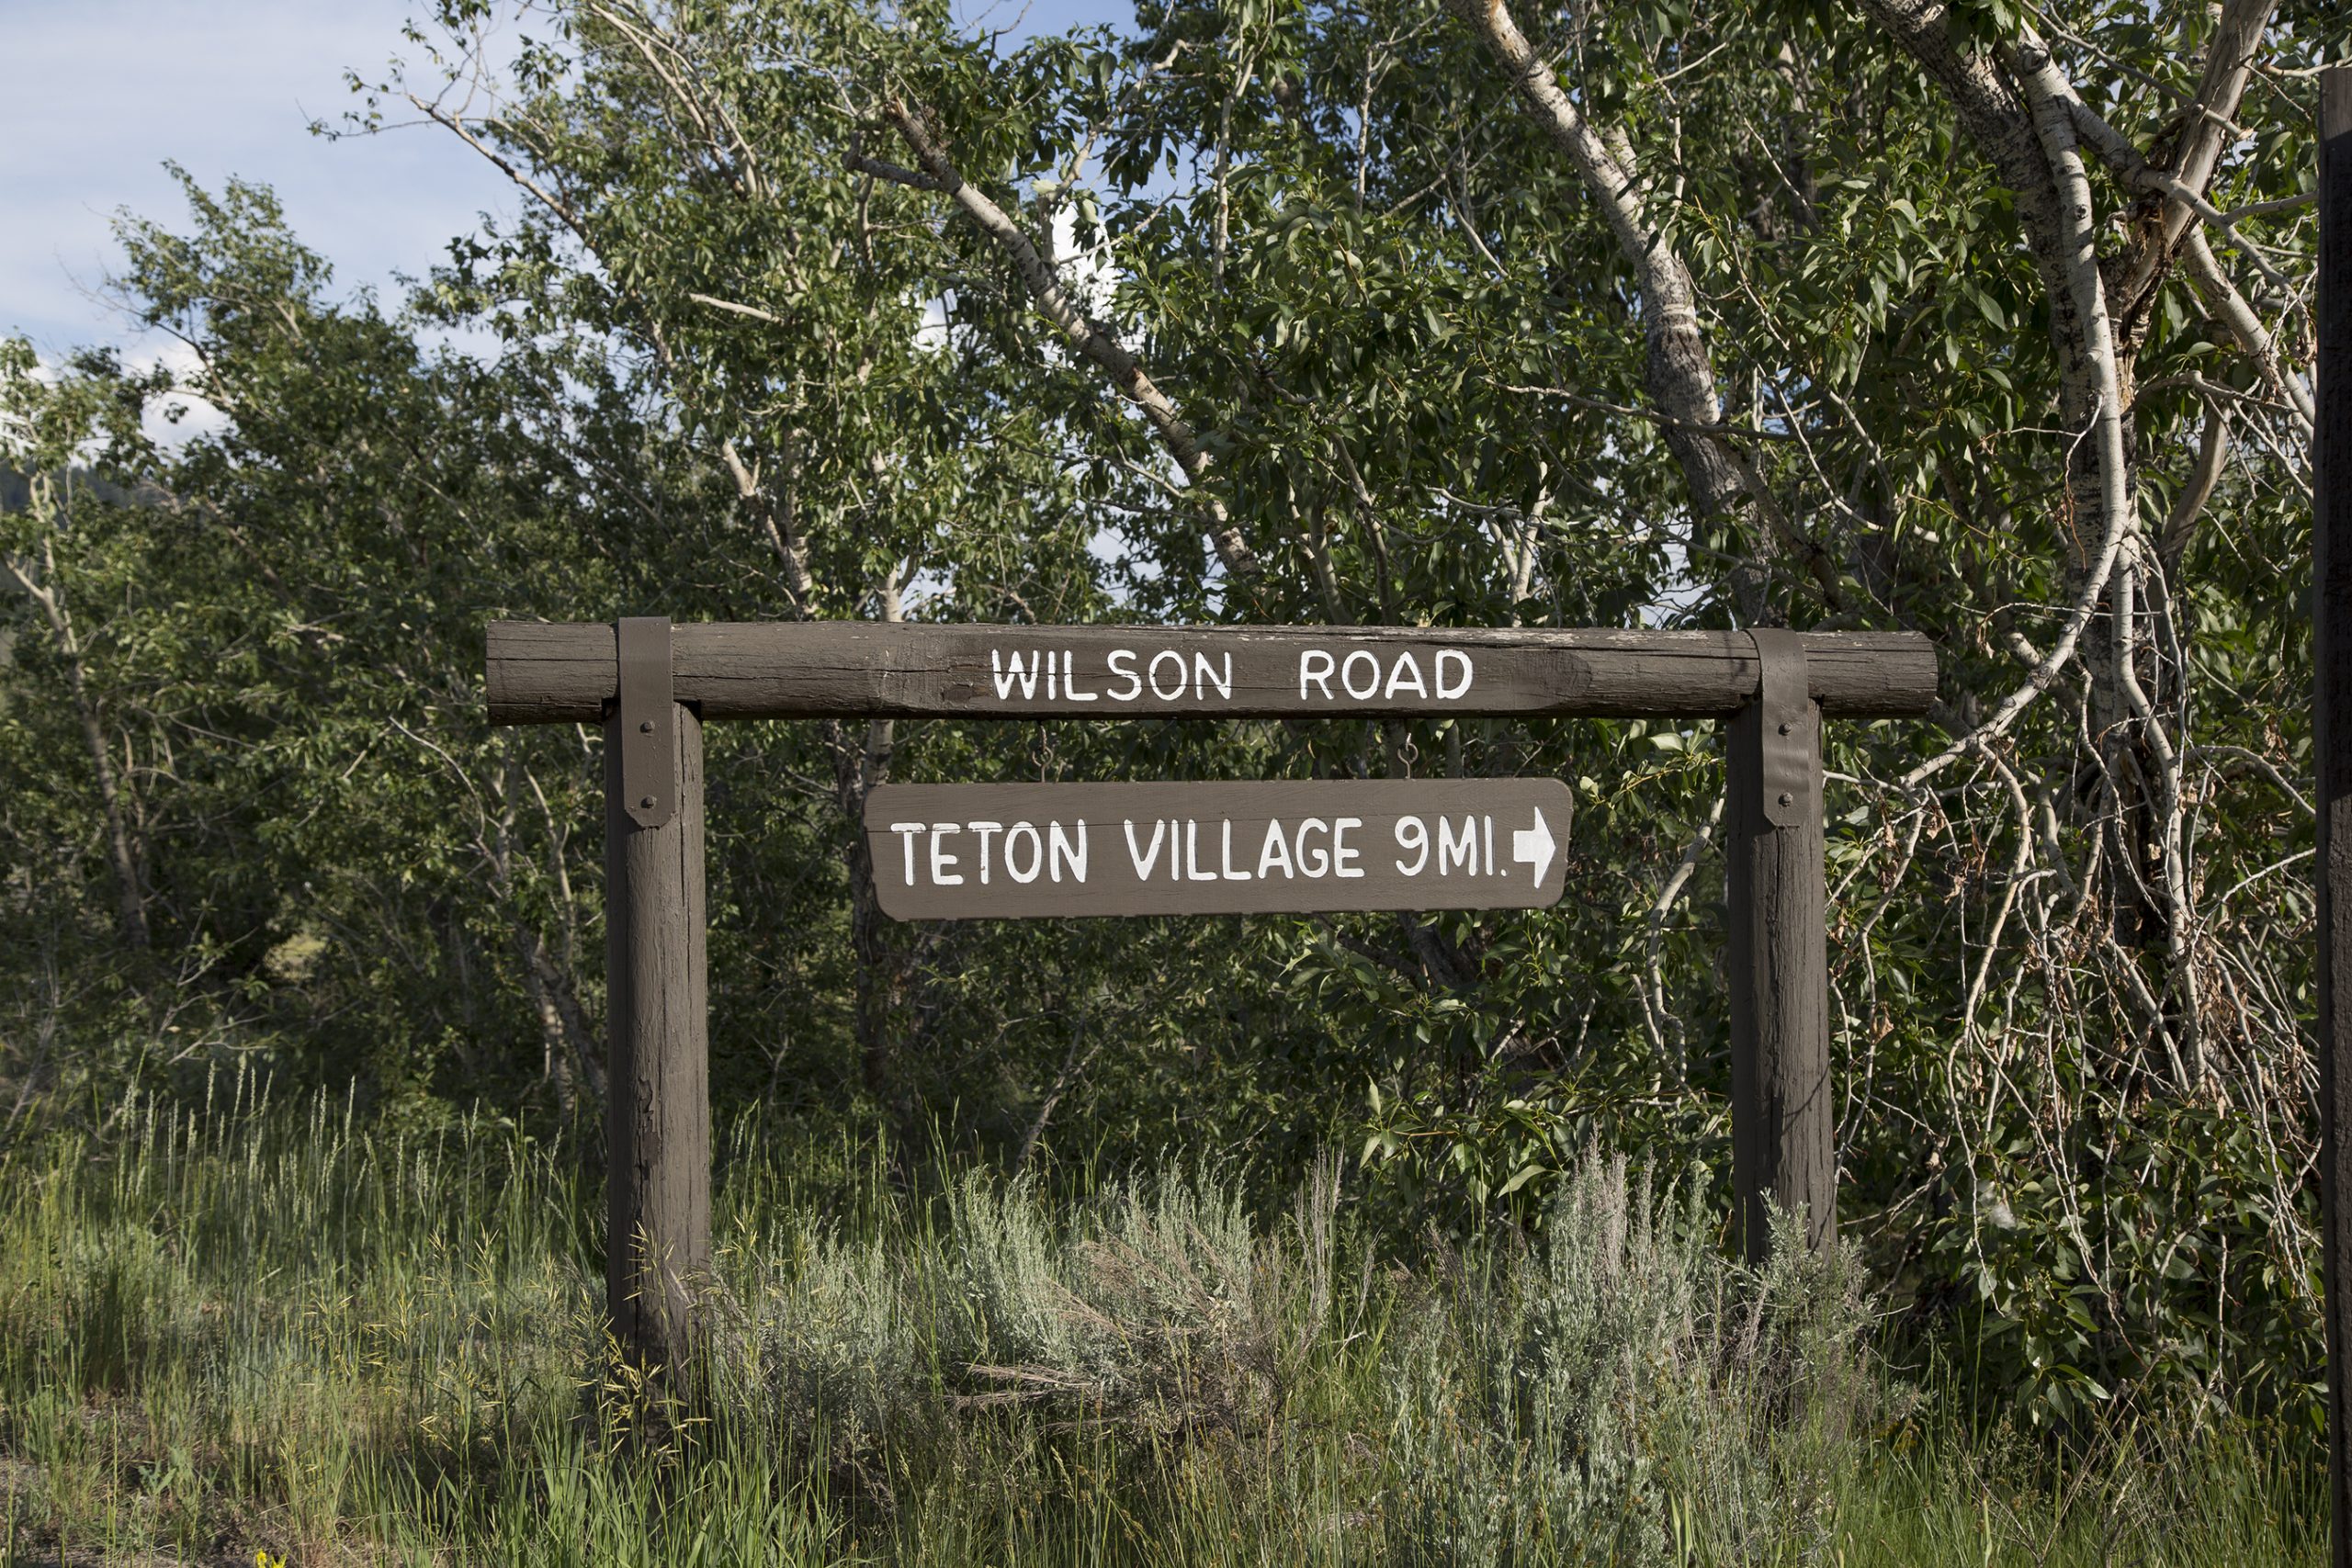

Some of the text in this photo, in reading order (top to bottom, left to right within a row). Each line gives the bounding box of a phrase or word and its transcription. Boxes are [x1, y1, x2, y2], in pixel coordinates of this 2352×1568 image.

[990, 649, 1475, 702] WILSON ROAD
[889, 818, 1089, 886] TETON
[1124, 817, 1365, 882] VILLAGE
